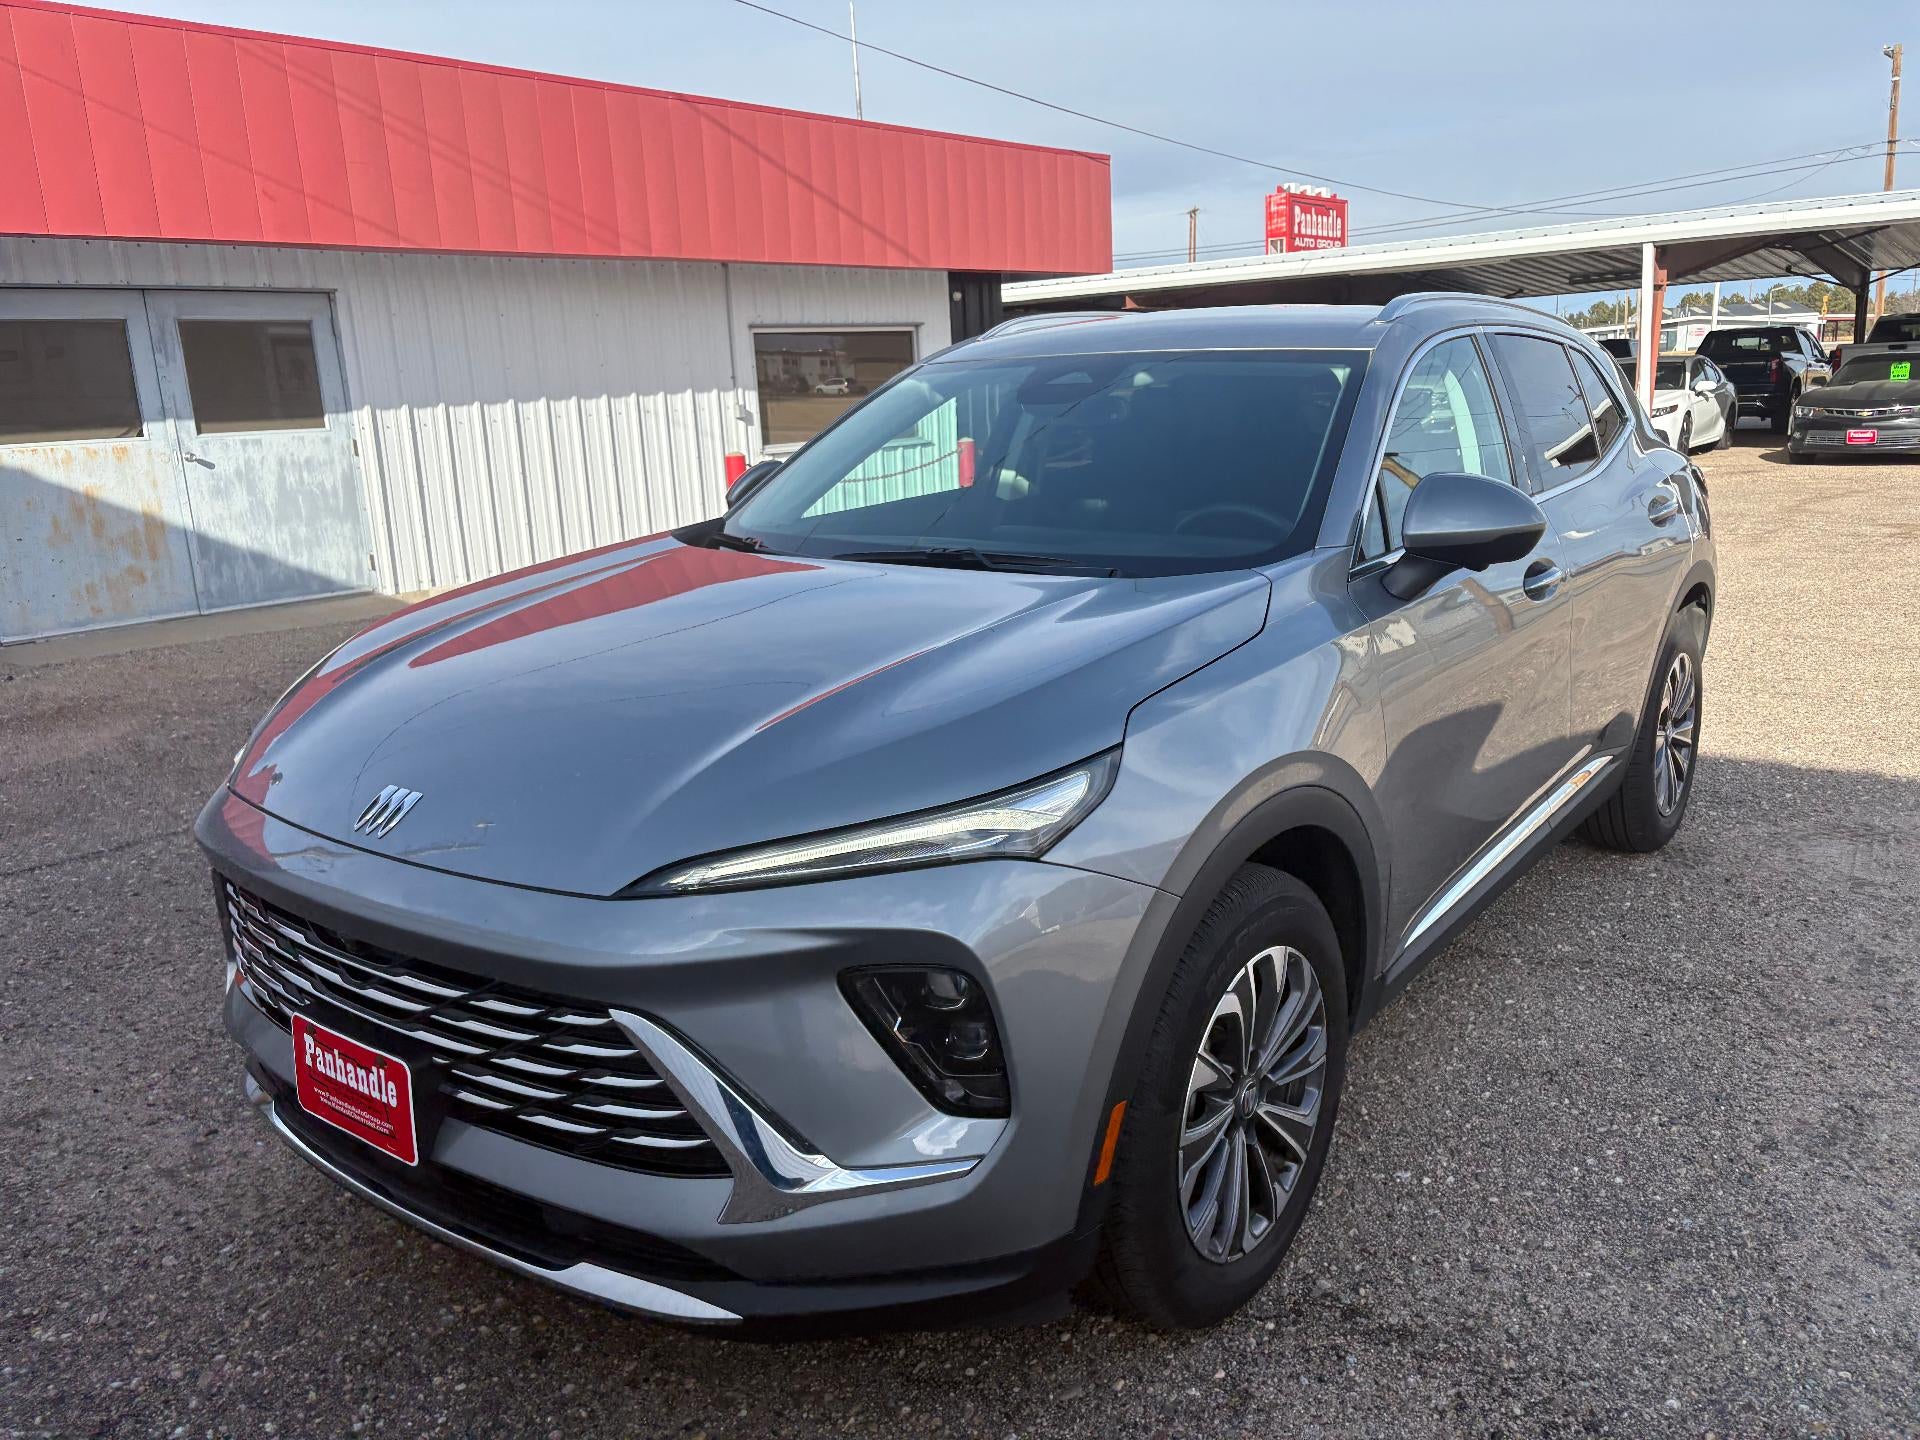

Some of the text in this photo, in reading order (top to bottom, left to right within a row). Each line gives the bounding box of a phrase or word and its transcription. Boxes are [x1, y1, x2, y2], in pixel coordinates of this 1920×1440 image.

[1294, 205, 1342, 238] Panhandle
[1295, 237, 1341, 248] AUTO GROUP
[304, 1032, 397, 1108] Panhandle
